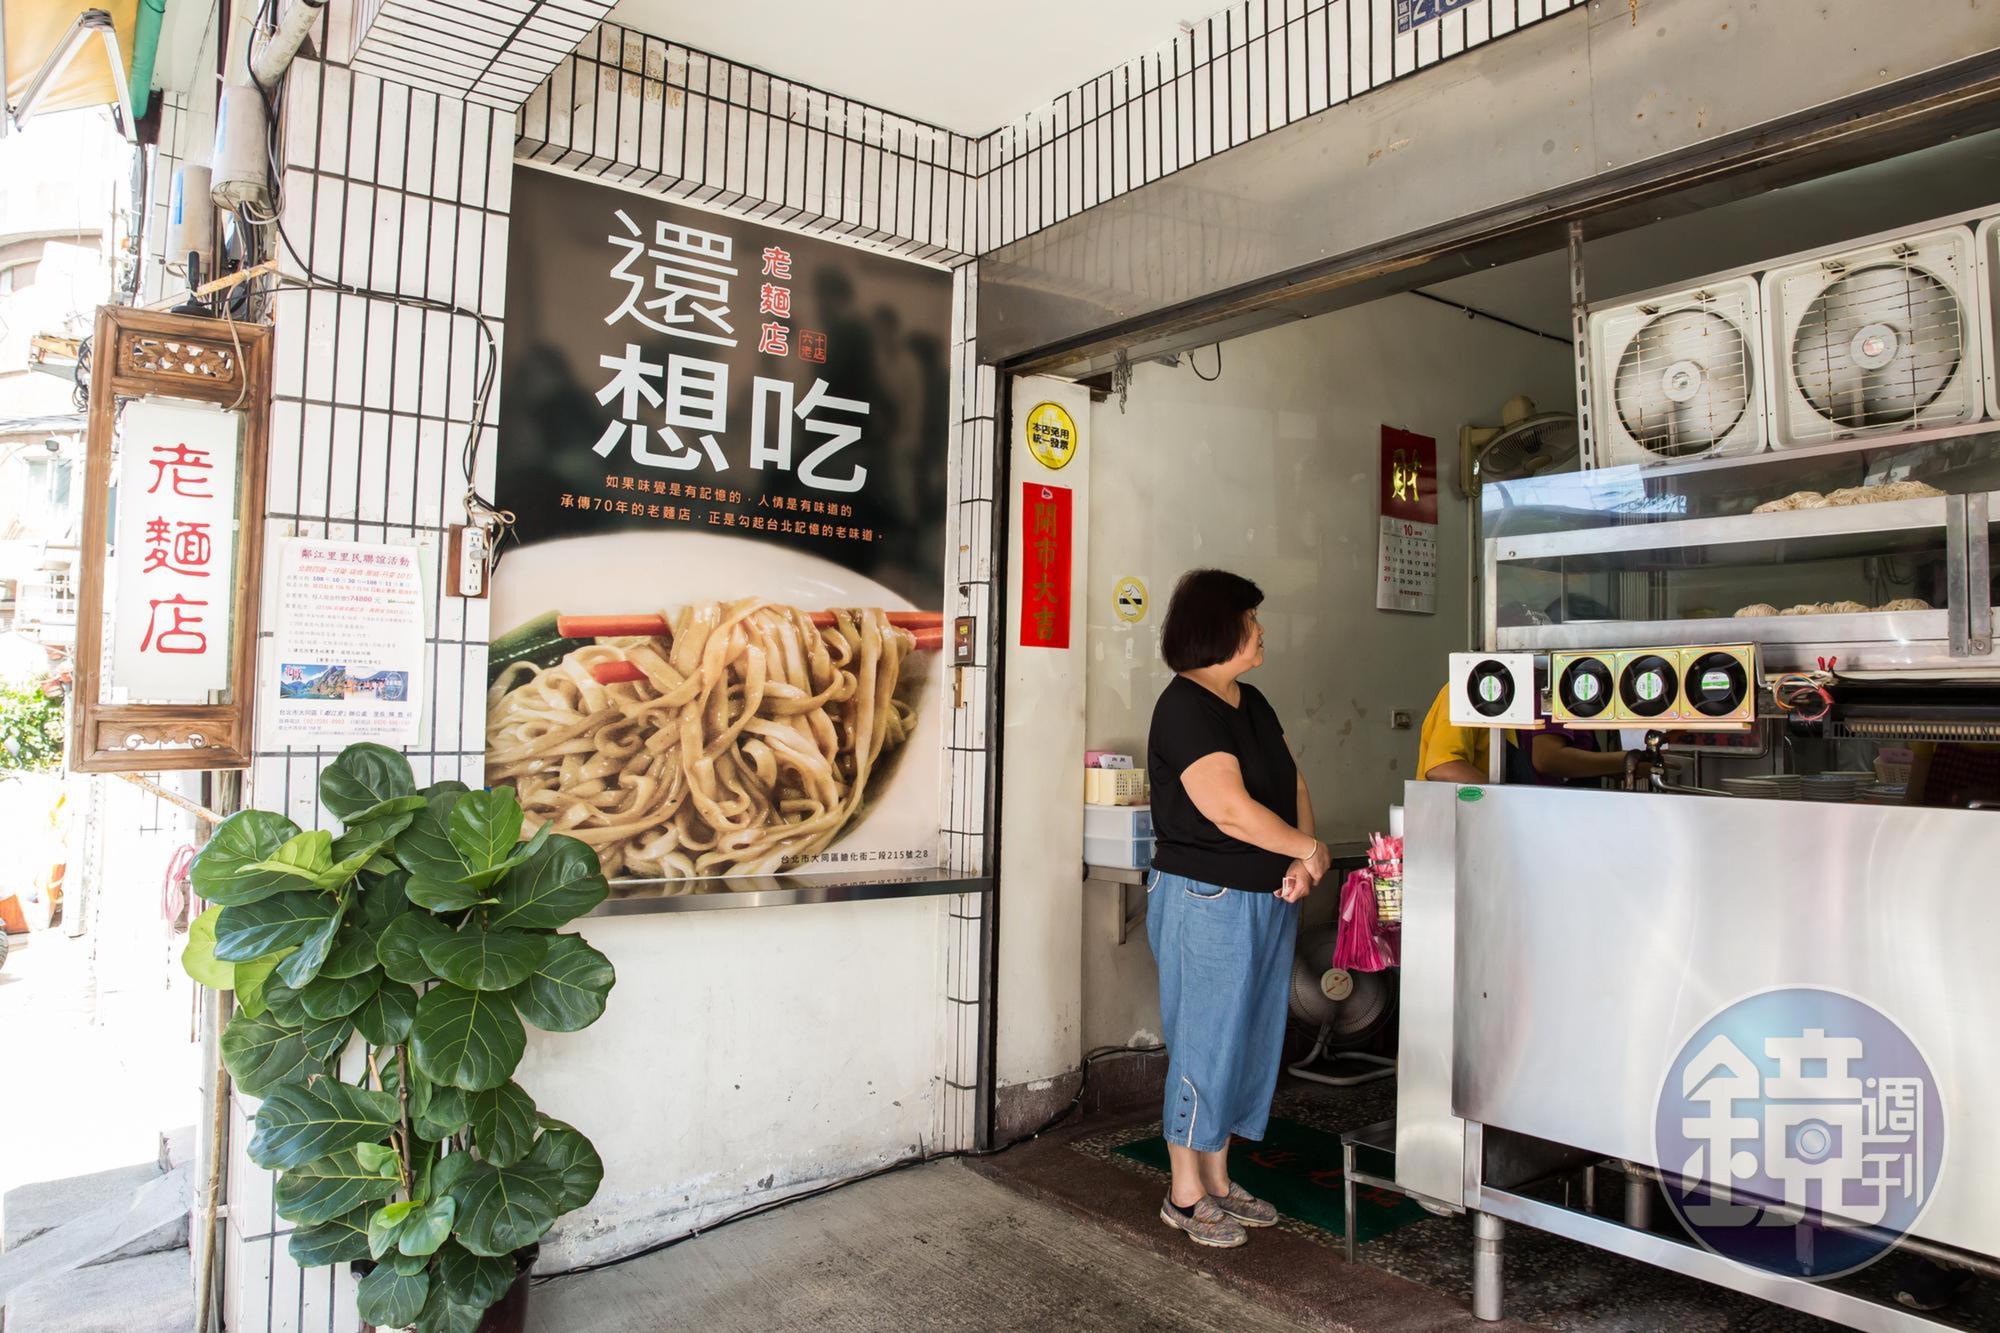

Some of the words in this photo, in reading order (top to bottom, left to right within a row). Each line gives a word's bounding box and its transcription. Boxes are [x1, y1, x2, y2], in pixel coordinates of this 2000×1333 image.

[603, 208, 738, 348] 還
[758, 246, 792, 357] 老麵店
[592, 343, 870, 493] 想吃
[1032, 422, 1069, 440] 本店免用
[1032, 432, 1069, 451] 統一發票
[140, 443, 213, 654] 老麵店
[1032, 502, 1058, 641] 開市大吉
